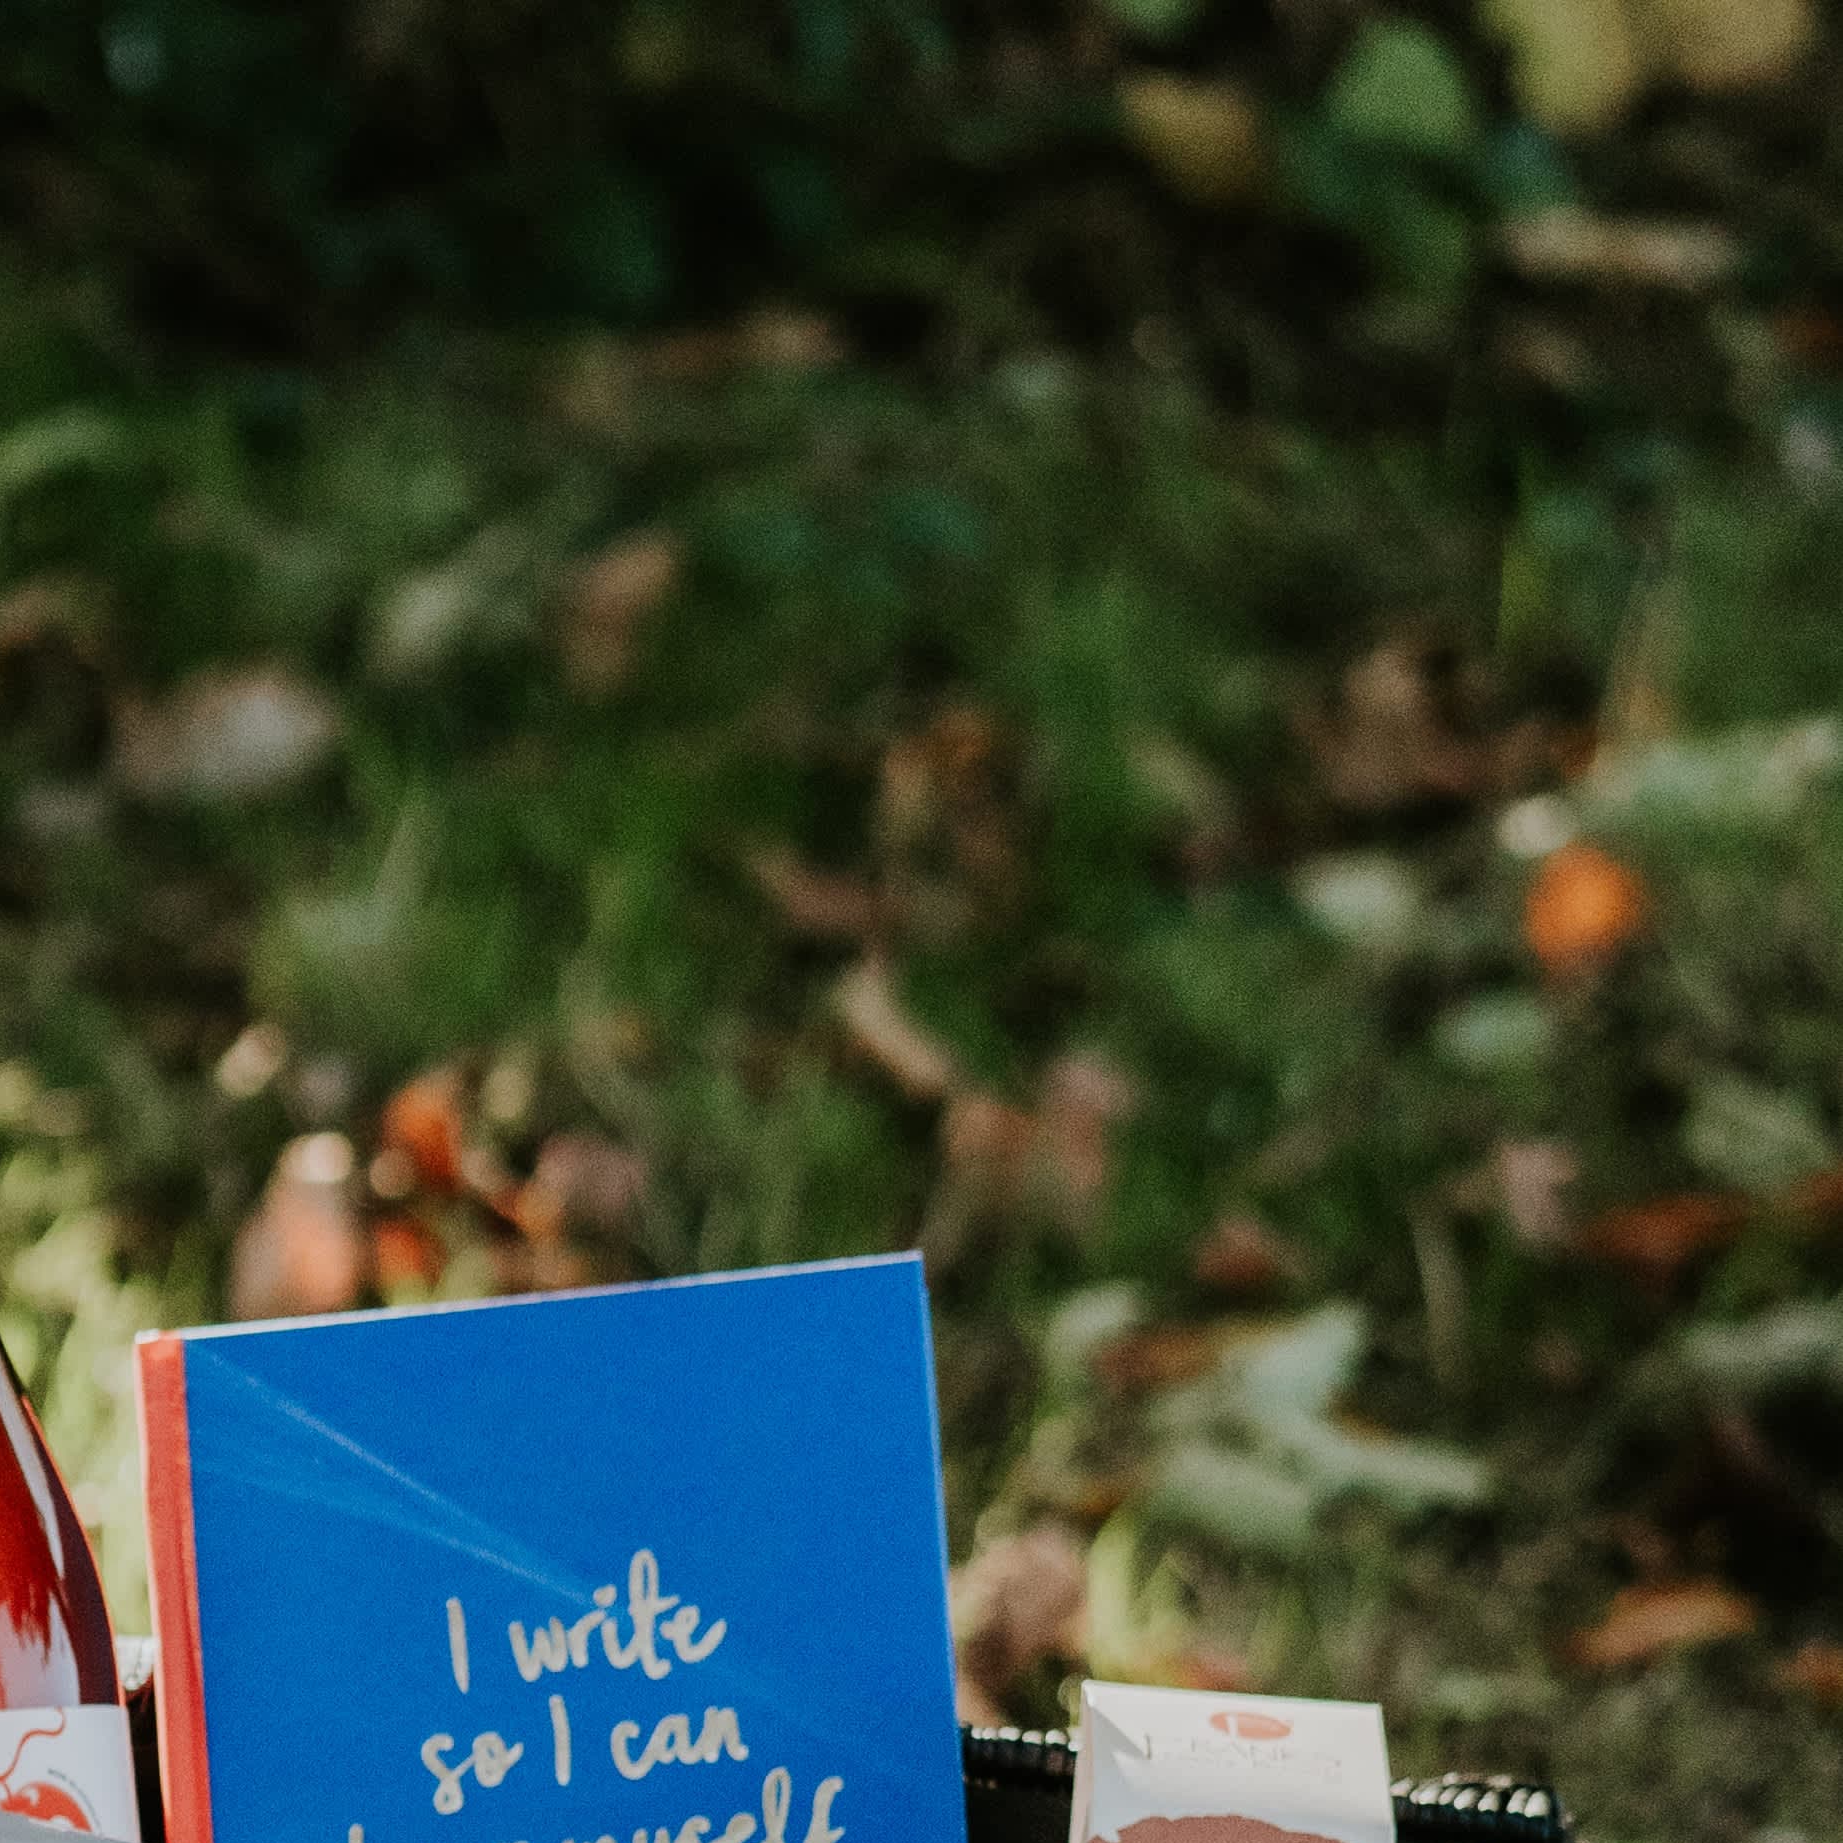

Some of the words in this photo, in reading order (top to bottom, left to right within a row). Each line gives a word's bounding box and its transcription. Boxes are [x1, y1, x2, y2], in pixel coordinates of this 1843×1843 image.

[446, 1598, 469, 1693] I
[509, 1550, 726, 1682] write
[421, 1732, 523, 1815] so
[549, 1695, 571, 1786] I
[610, 1706, 749, 1780] can
